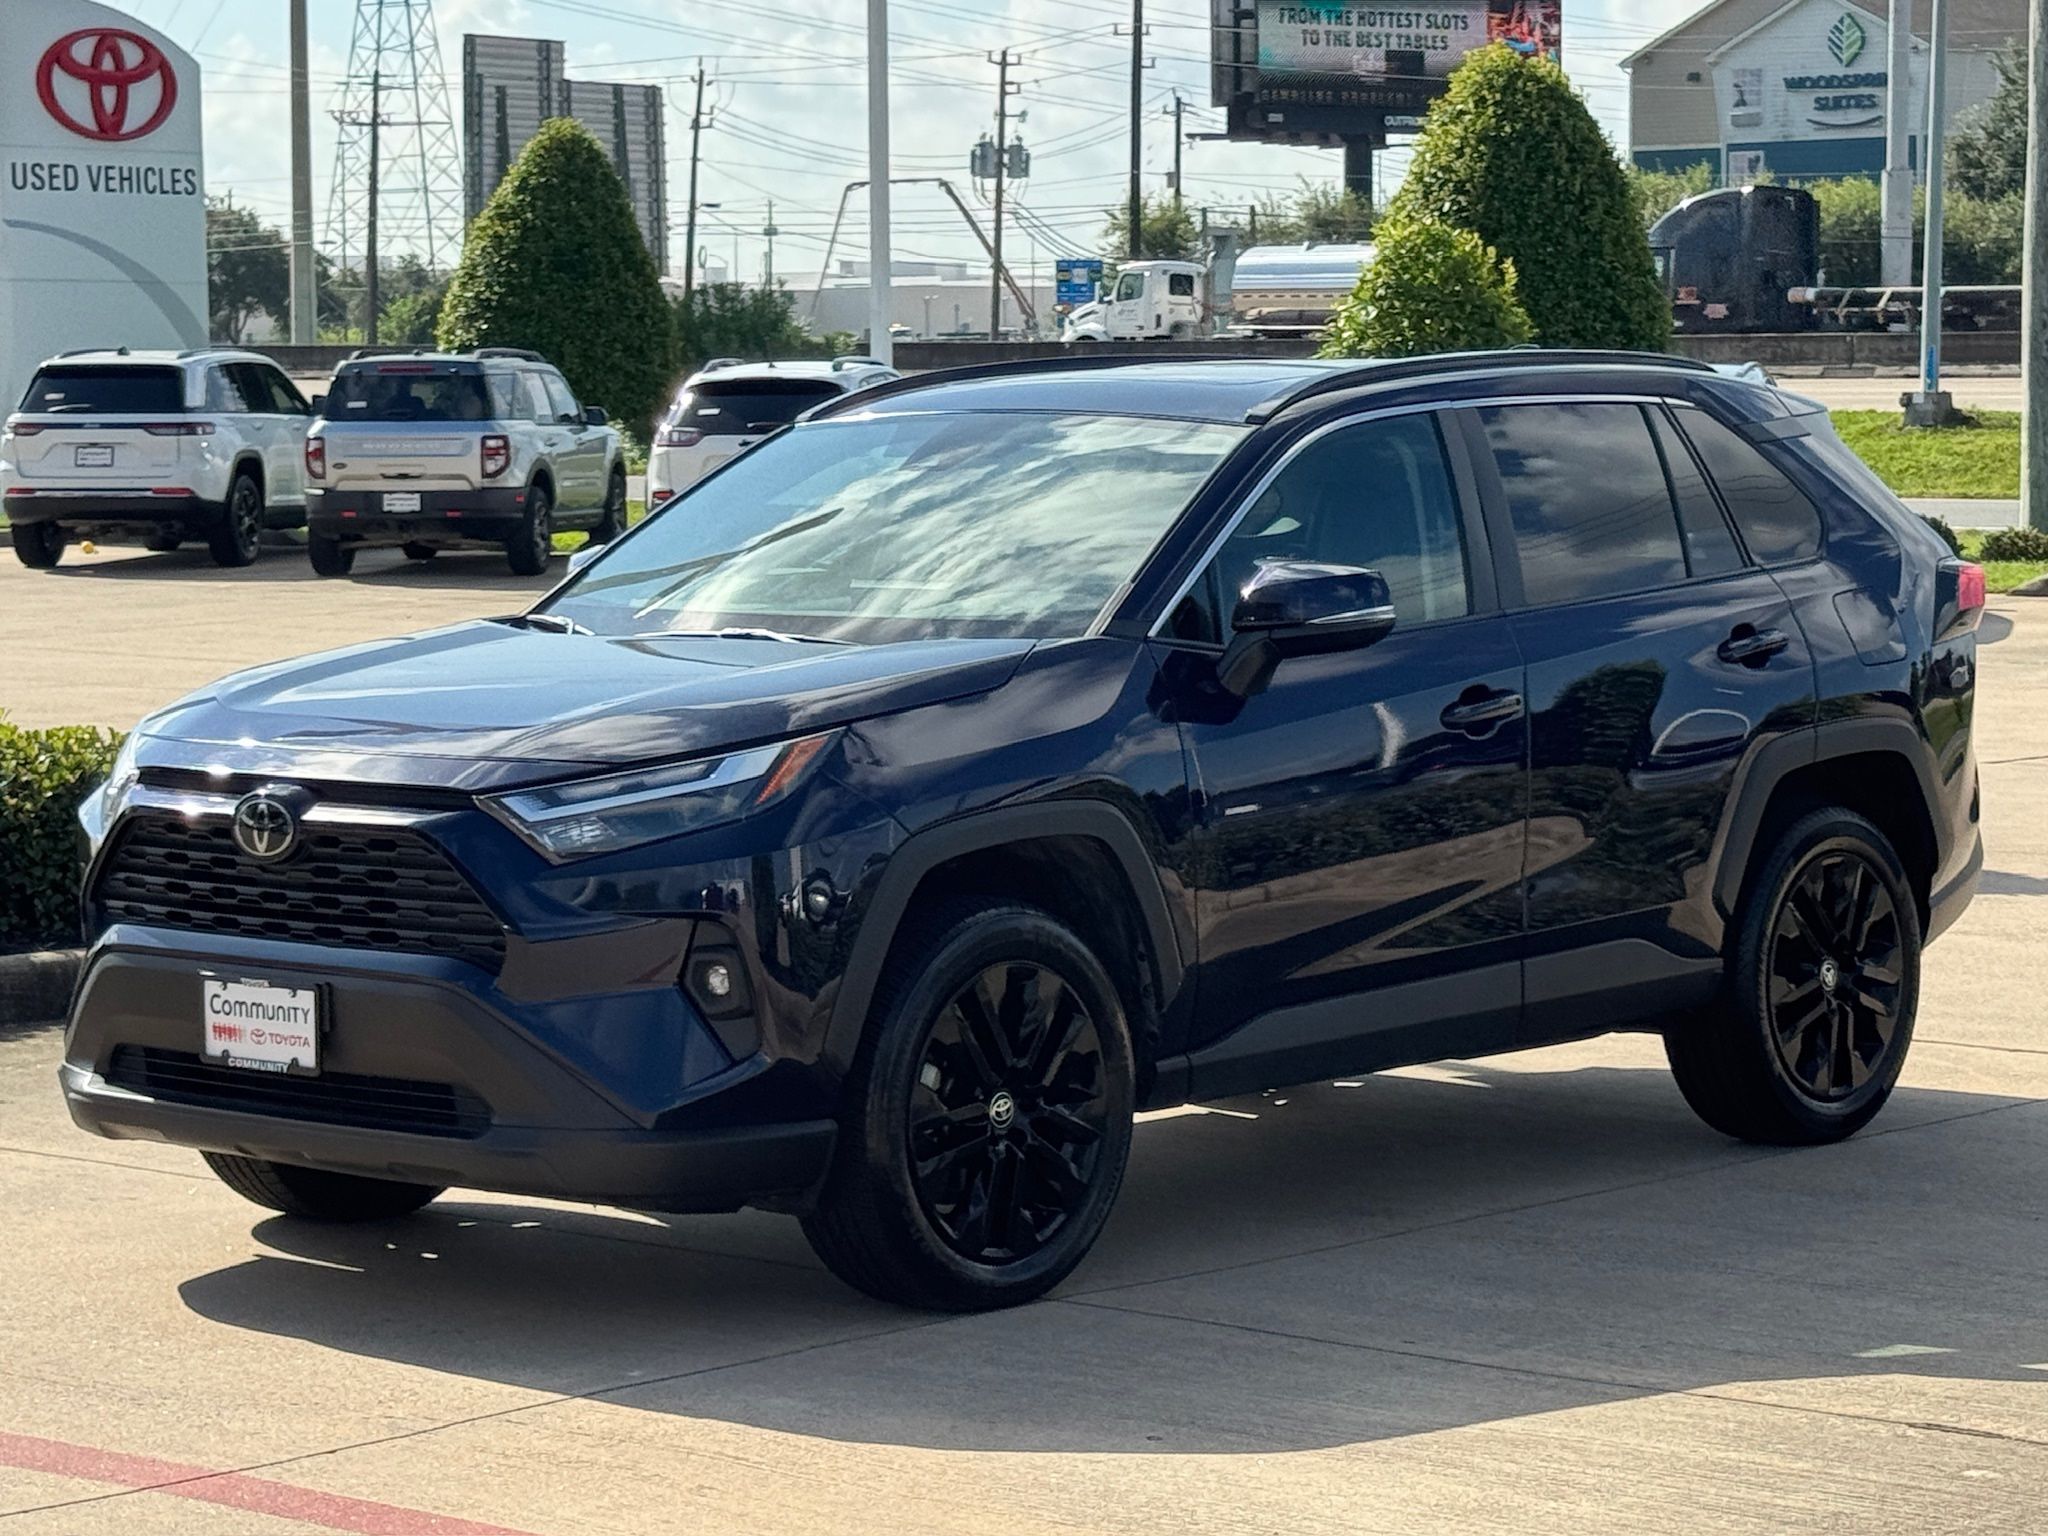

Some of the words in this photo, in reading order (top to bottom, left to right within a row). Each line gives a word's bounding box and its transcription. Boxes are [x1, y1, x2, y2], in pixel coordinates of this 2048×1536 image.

[1279, 7, 1321, 25] FROM
[1325, 9, 1353, 27] THE
[1356, 10, 1423, 30] HOTTEST
[1425, 13, 1469, 31] SLOTS
[1301, 29, 1320, 47] TO
[1324, 30, 1351, 47] THE
[1356, 32, 1391, 49] BEST
[1396, 34, 1449, 51] TABLES
[11, 162, 80, 192] USED
[86, 164, 197, 196] VEHICLES
[269, 1031, 311, 1049] TOYOTA
[227, 1057, 289, 1073] COMMUNITY
